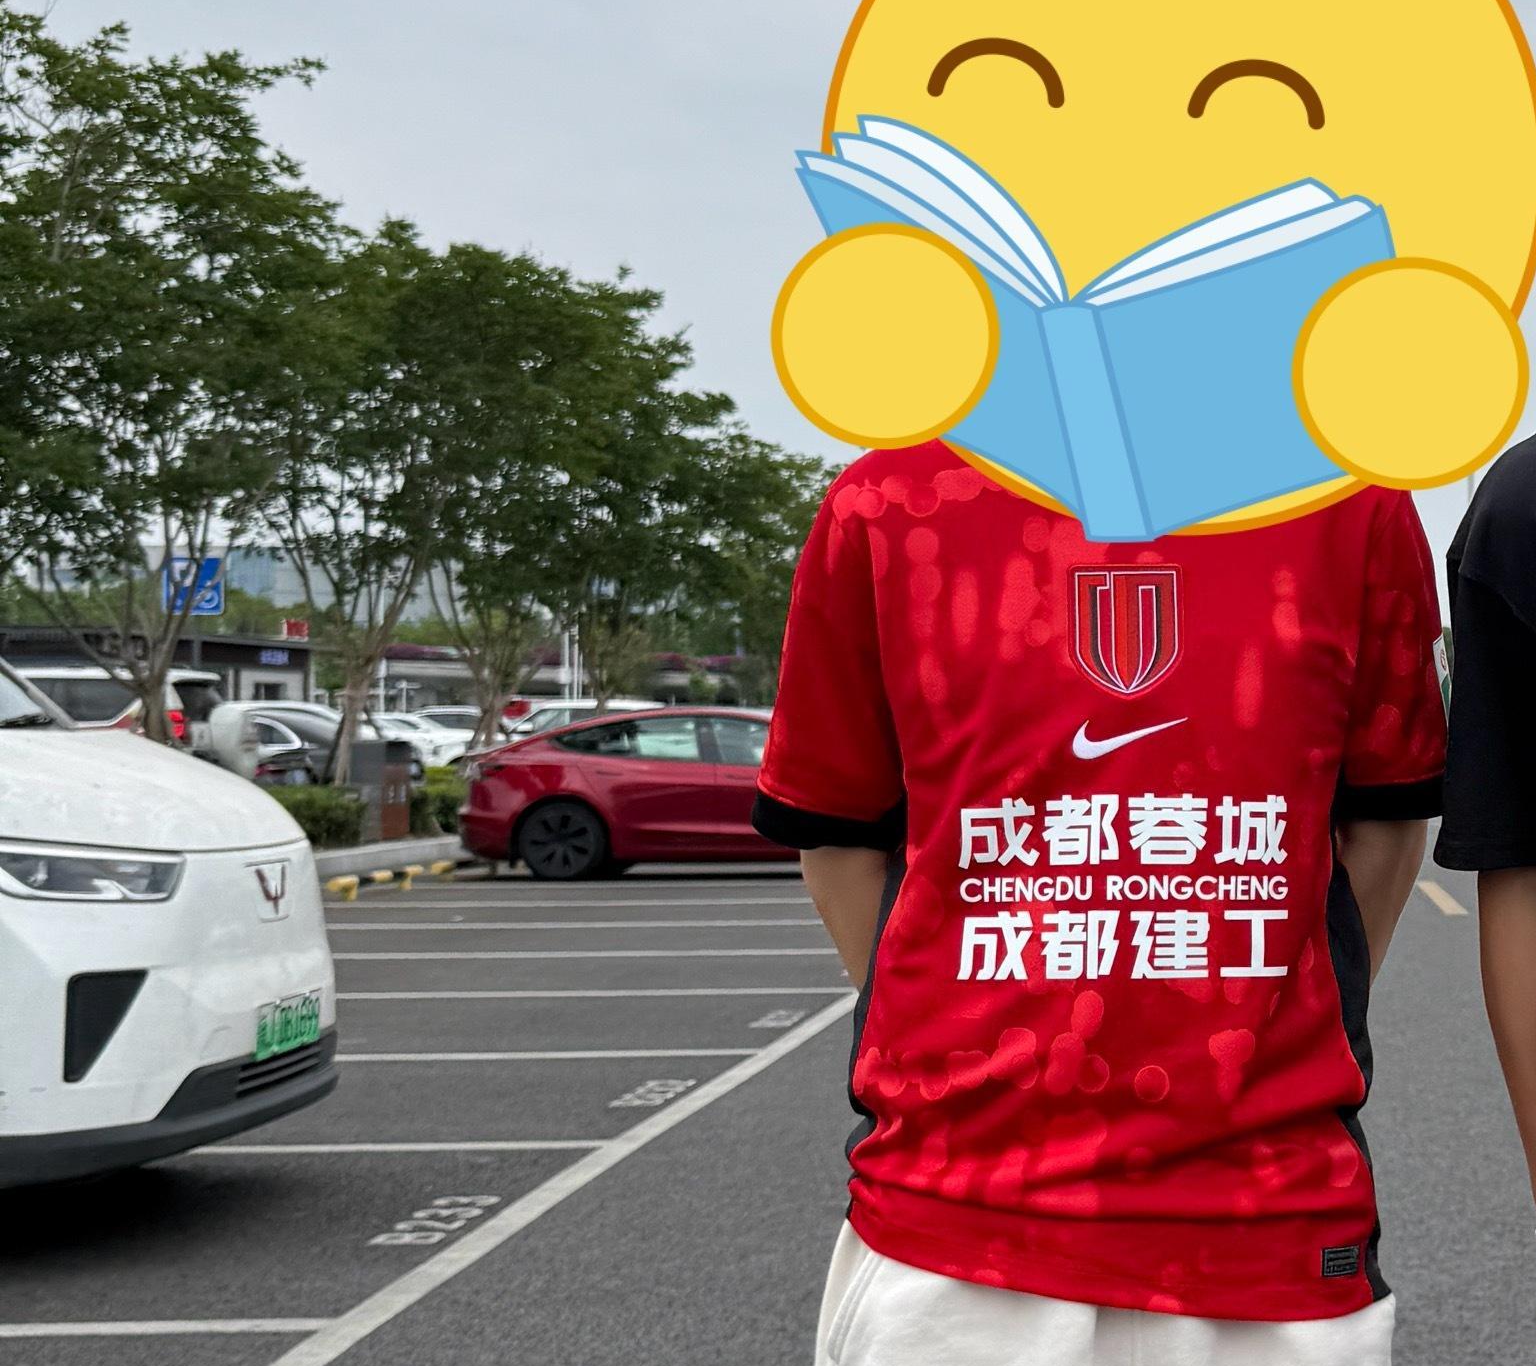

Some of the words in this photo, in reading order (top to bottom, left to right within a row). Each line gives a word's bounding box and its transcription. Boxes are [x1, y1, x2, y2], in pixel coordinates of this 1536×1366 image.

[958, 792, 1288, 869] 成都蓉城
[959, 874, 1093, 902] CHENGDU
[1106, 874, 1289, 901] RONGCHENG
[957, 909, 1289, 981] 成都建工
[365, 1195, 500, 1247] B233
